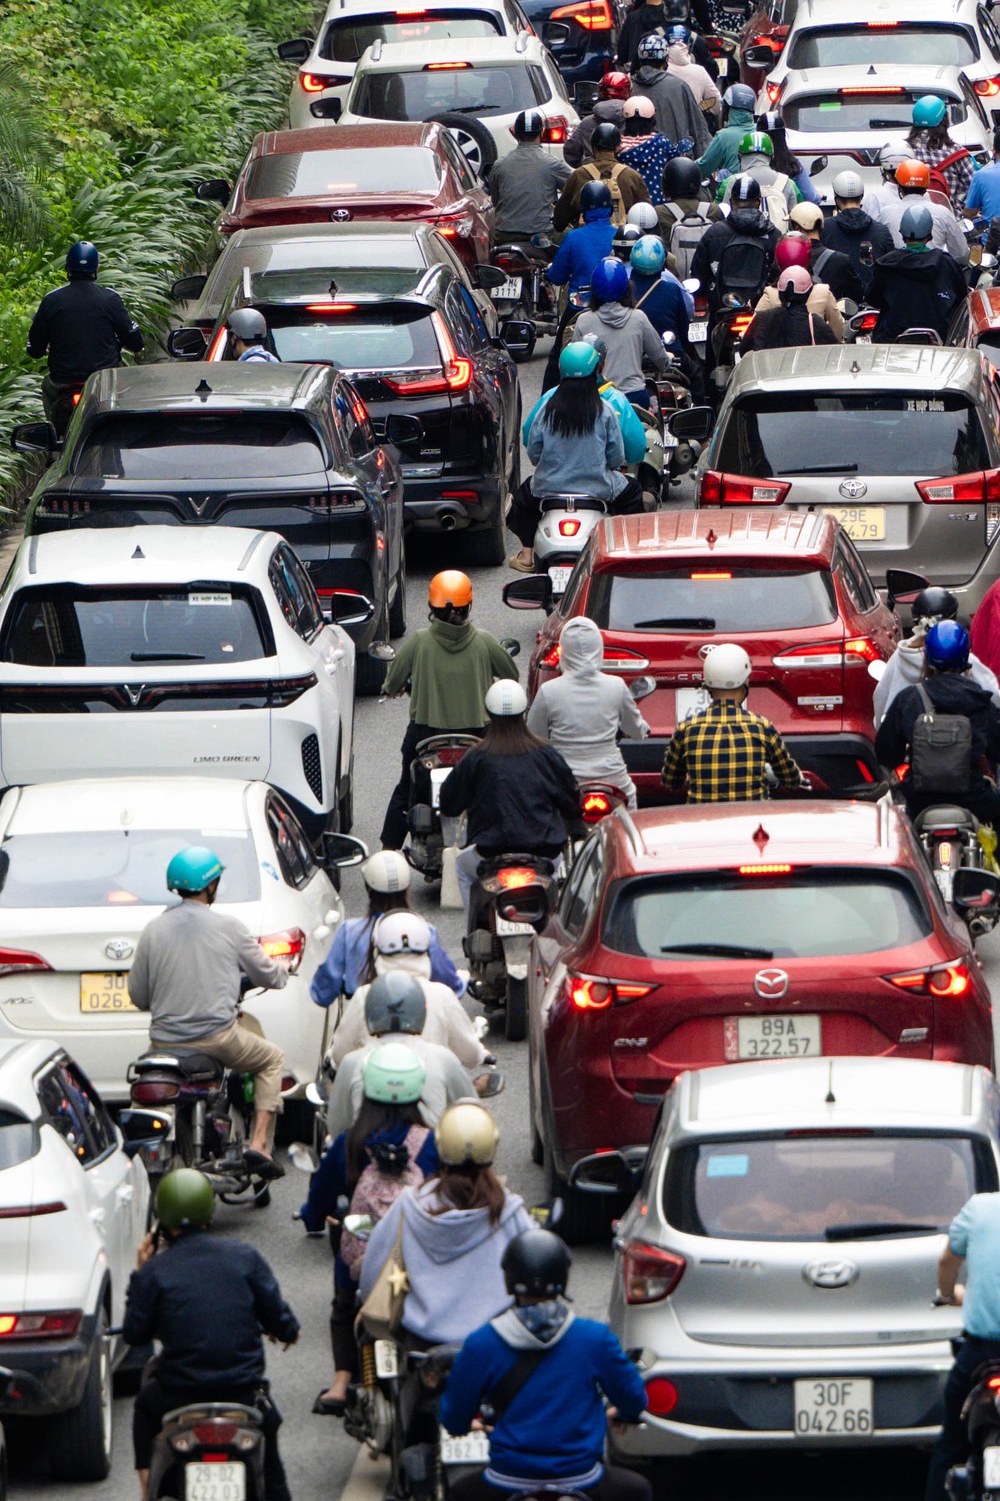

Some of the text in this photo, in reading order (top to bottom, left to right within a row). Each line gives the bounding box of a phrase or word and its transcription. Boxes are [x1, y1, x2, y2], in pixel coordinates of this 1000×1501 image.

[494, 288, 517, 297] 3111
[839, 509, 867, 523] 29E
[761, 1018, 796, 1036] 89A
[613, 1037, 649, 1047] CX-5
[747, 1037, 811, 1056] 322.57
[813, 1383, 852, 1406] 30F
[796, 1409, 871, 1433] 042.66
